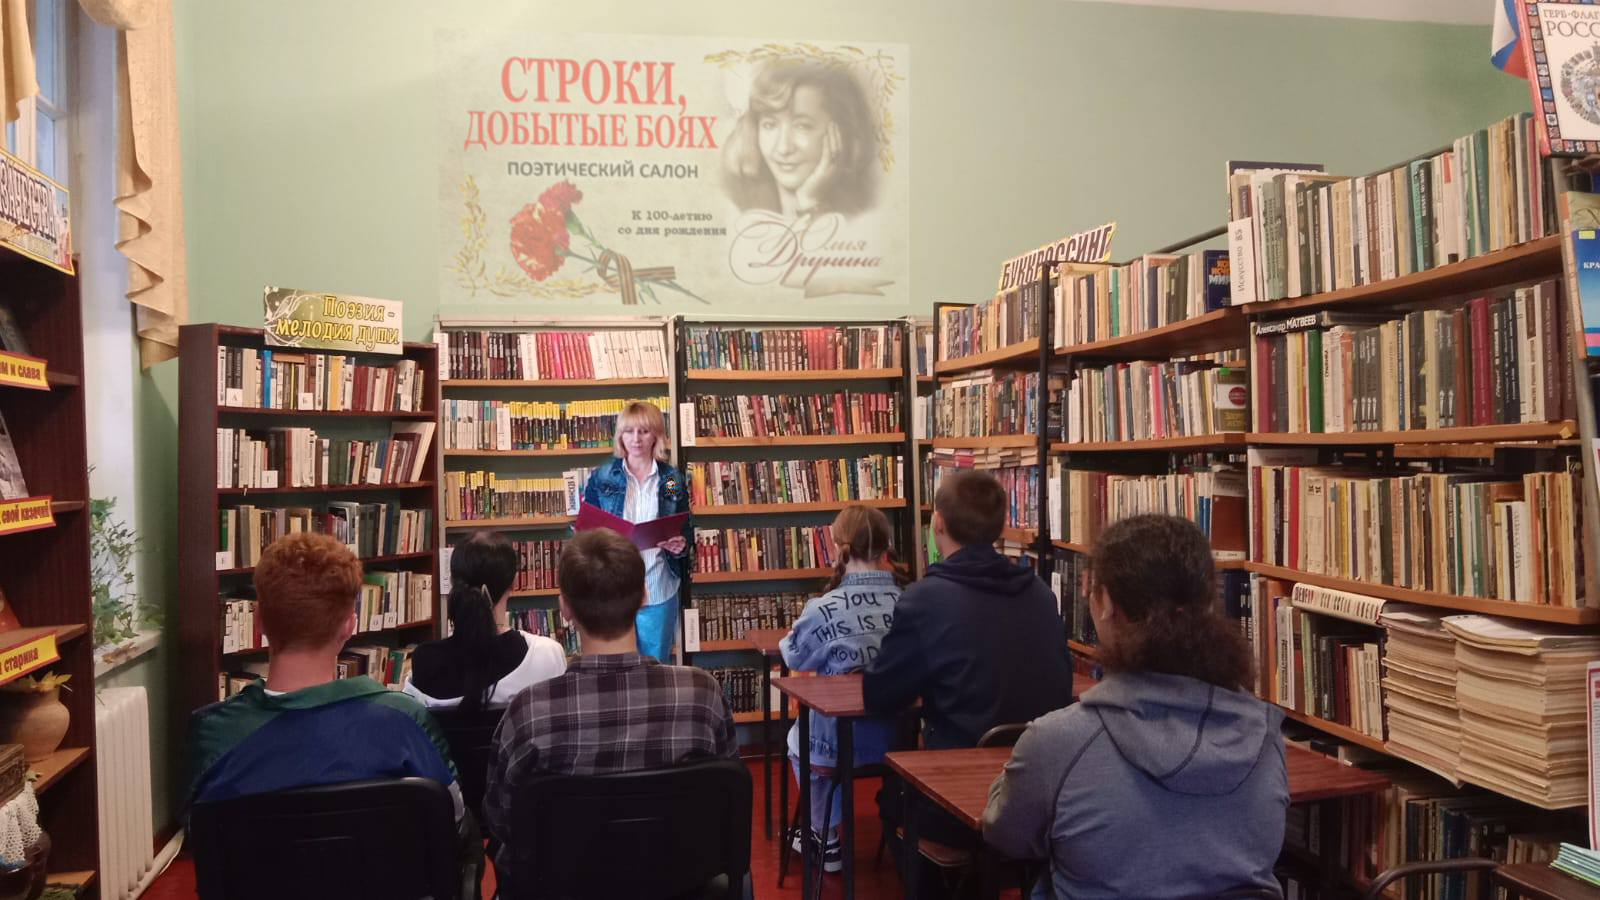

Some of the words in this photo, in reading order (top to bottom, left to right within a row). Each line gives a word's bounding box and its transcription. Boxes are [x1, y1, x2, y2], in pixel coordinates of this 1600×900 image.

[500, 56, 687, 115] СТРОКИ,
[464, 110, 629, 151] ДОБЫТЫЕ
[635, 113, 719, 150] БОЯХ
[506, 159, 635, 178] ПОЭТИЧЕСКИЙ
[639, 163, 699, 179] САЛОН
[631, 210, 642, 221] К
[646, 210, 713, 221] 100-летию
[617, 226, 632, 235] со
[635, 226, 660, 236] дня
[664, 226, 727, 237] рождения
[323, 295, 385, 322] Поэзия
[1286, 314, 1316, 330] МАТВЕЕВ
[356, 325, 399, 352] души
[818, 601, 838, 622] IF
[832, 591, 881, 610] YOU
[811, 620, 851, 643] THIS
[857, 614, 876, 631] IS
[4, 647, 38, 672] старина
